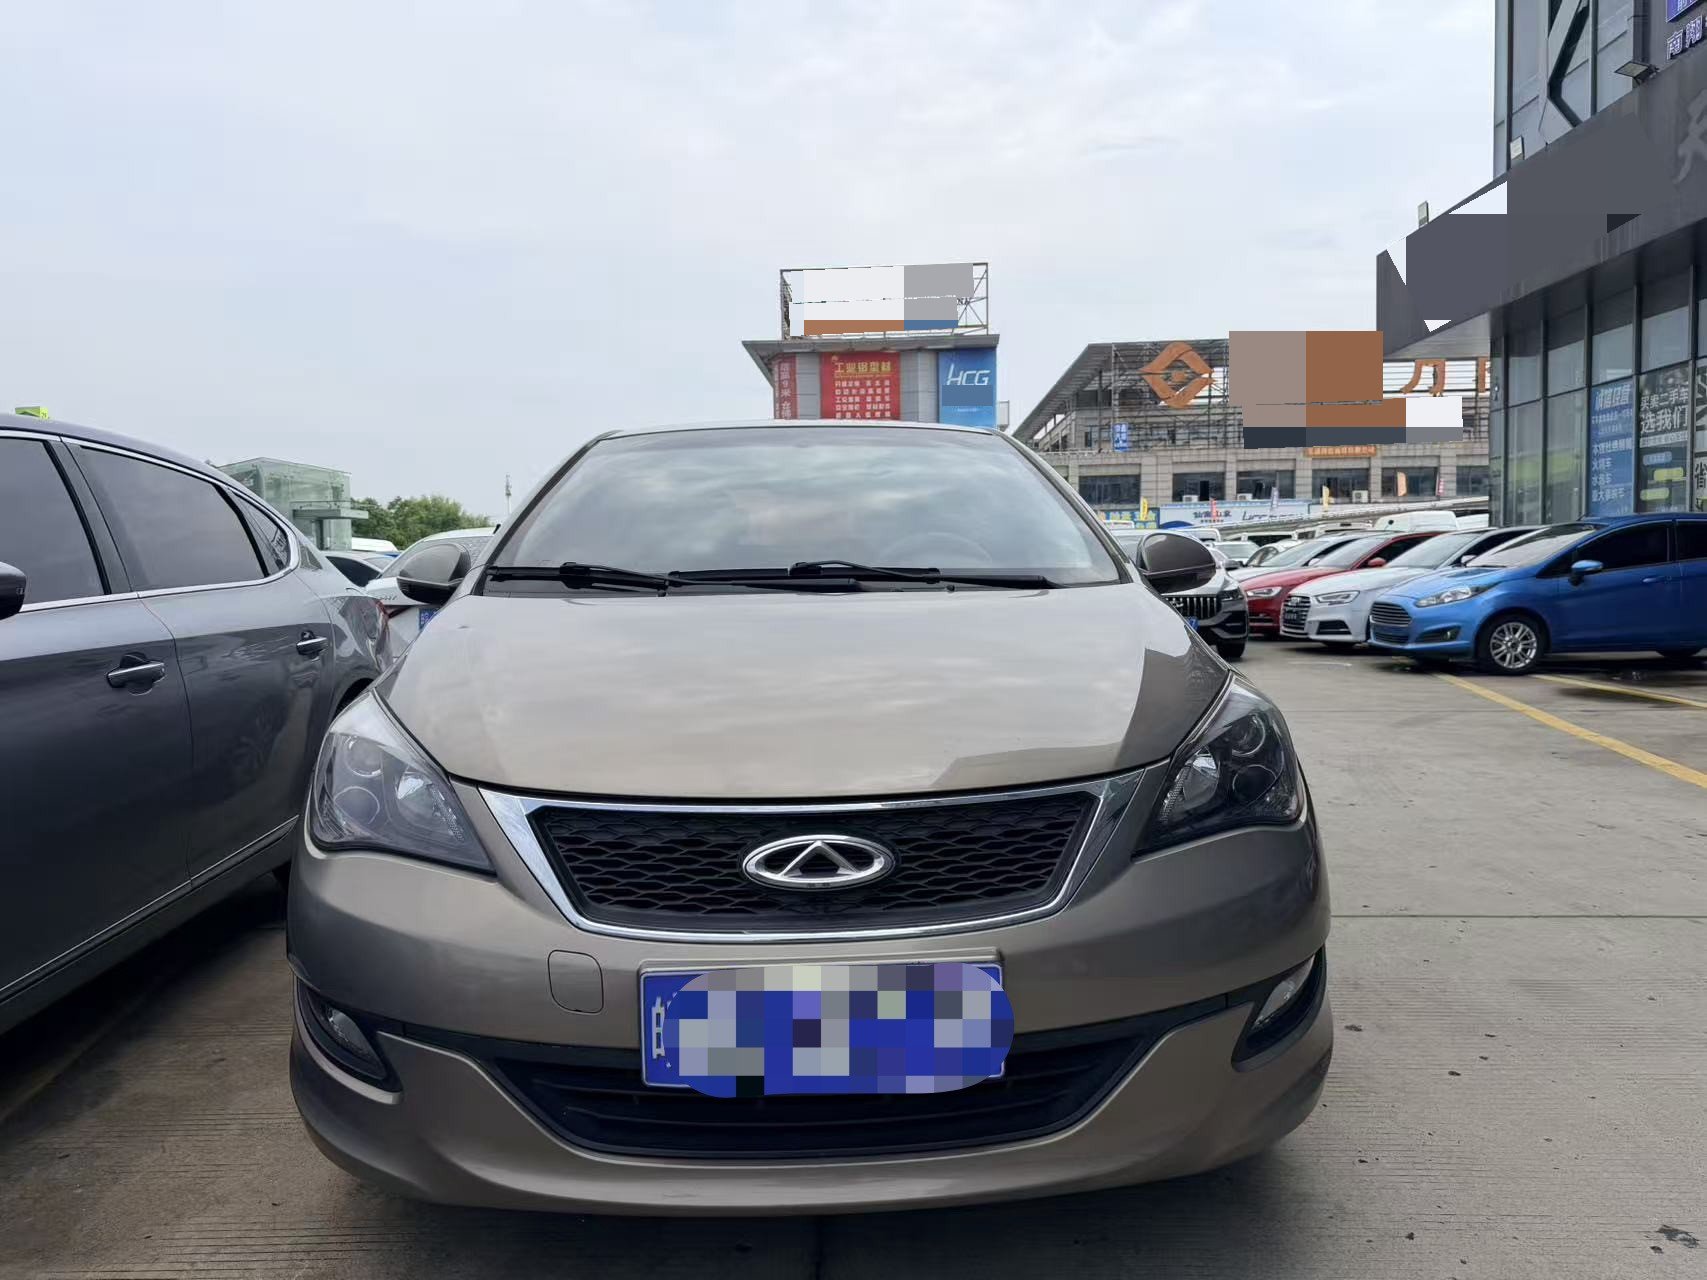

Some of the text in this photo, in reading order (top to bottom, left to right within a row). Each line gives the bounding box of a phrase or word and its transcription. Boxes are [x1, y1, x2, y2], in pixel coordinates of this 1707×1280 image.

[946, 363, 991, 386] HCG
[1640, 386, 1689, 411] 买卖二手车
[1640, 405, 1688, 434] 选我们
